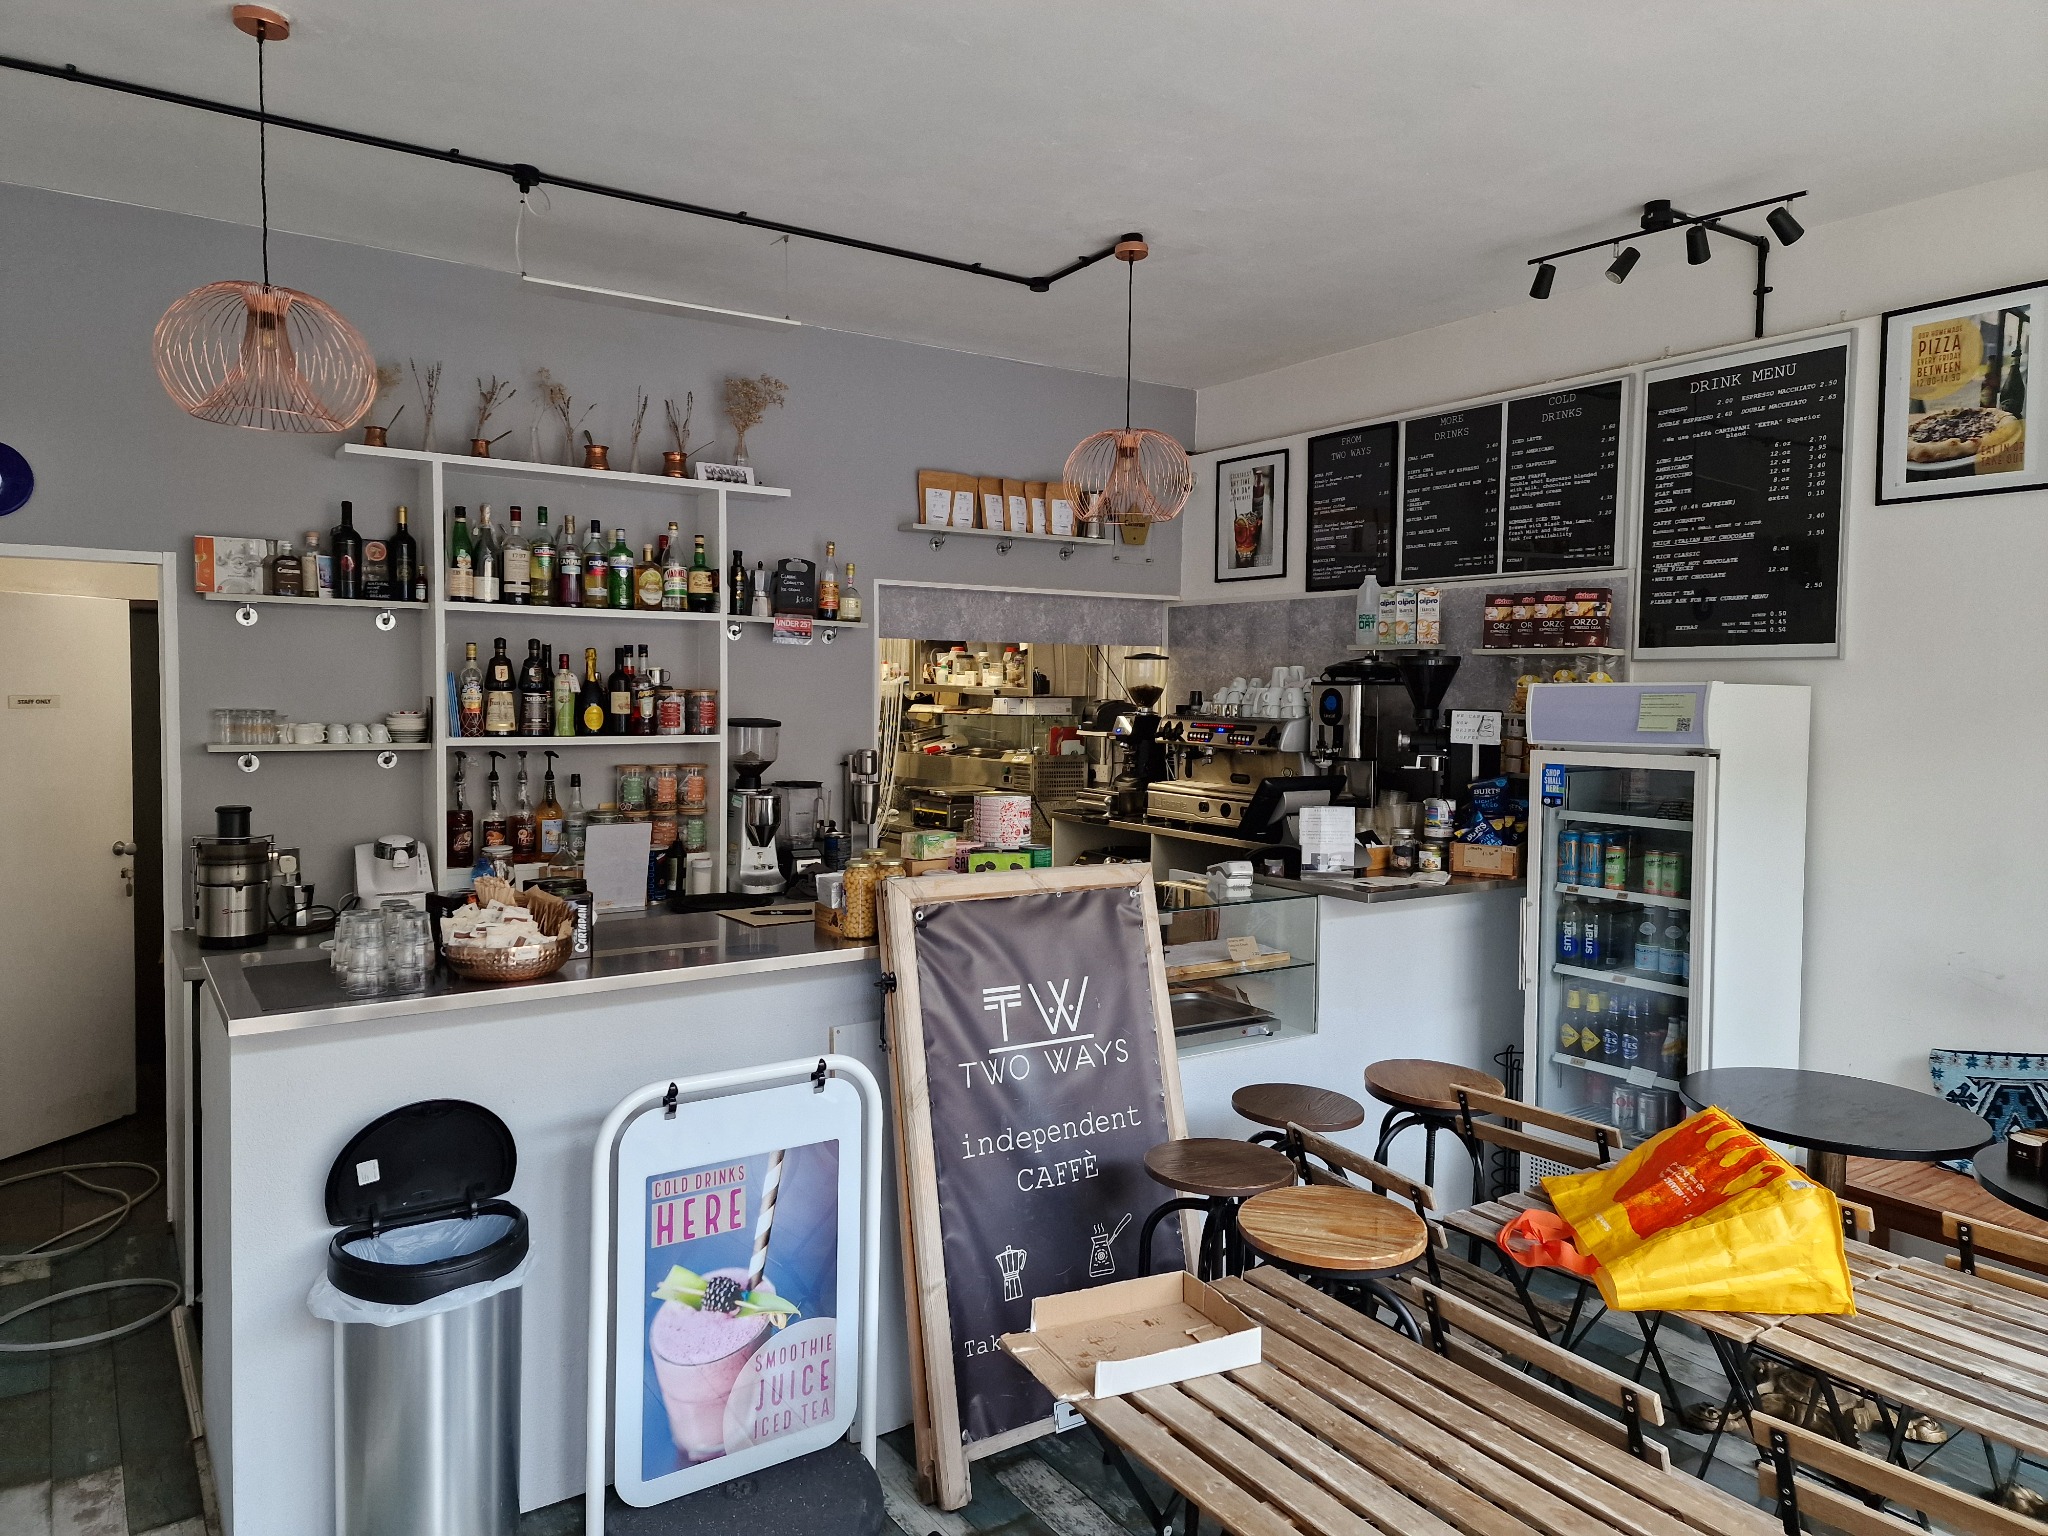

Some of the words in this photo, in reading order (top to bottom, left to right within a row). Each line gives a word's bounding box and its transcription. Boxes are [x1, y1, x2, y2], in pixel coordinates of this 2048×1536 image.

[1918, 331, 1930, 340] OUR
[1931, 324, 1963, 337] HOMEMADE
[1918, 334, 1962, 357] PIZZA
[1917, 355, 1936, 366] EVERY
[1938, 352, 1962, 363] FRIDAY
[1916, 360, 1962, 378] BETWEEN
[1690, 373, 1742, 394] DRINK
[1751, 363, 1797, 383] MENU
[1741, 390, 1775, 401] ESPRESSO
[1777, 383, 1816, 395] MACCHIATO
[1819, 379, 1838, 388] 2.50
[1548, 393, 1577, 406] COLD
[1440, 414, 1464, 426] MORE
[1541, 407, 1583, 423] DRINKS
[1657, 420, 1680, 429] DOUBLE
[1682, 414, 1714, 424] ESPRESSO
[1740, 405, 1766, 415] DOUBLE
[1768, 398, 1808, 410] MACCHIATO
[1341, 434, 1362, 446] FROM
[1434, 427, 1469, 441] DRINKS
[1809, 434, 1827, 443] 2.70
[1331, 451, 1347, 461] TWO
[1350, 446, 1372, 457] WAYS
[1809, 444, 1827, 452] 2.95
[1981, 444, 1995, 456] EAT
[1999, 443, 2011, 454] IN
[1981, 454, 2003, 467] TAKE
[2006, 452, 2024, 464] OUT
[1573, 471, 1598, 479] blended
[1534, 532, 1573, 540] availability
[1397, 598, 1416, 607] alpro
[1419, 597, 1438, 605] alpro
[776, 619, 799, 627] UNDER
[1358, 620, 1376, 630] OAT
[1573, 618, 1599, 626] ORZO
[1545, 768, 1561, 777] SHOP
[1543, 776, 1562, 786] SMALL
[1546, 785, 1560, 793] HERE
[574, 904, 588, 953] CARTAPANI
[1563, 920, 1573, 952] smart
[1585, 923, 1594, 955] smart
[958, 1053, 1031, 1089] TWO
[1044, 1038, 1130, 1074] WAYS
[962, 1104, 1143, 1160] independent
[1016, 1150, 1100, 1192] CAFFÈ
[654, 1176, 689, 1198] COLD
[695, 1165, 746, 1190] DRINKS
[655, 1187, 744, 1246] HERE
[755, 1333, 834, 1373] SMOOTHIE
[755, 1358, 830, 1412] JUICE
[754, 1408, 793, 1440] ICED
[801, 1400, 831, 1429] TEA
